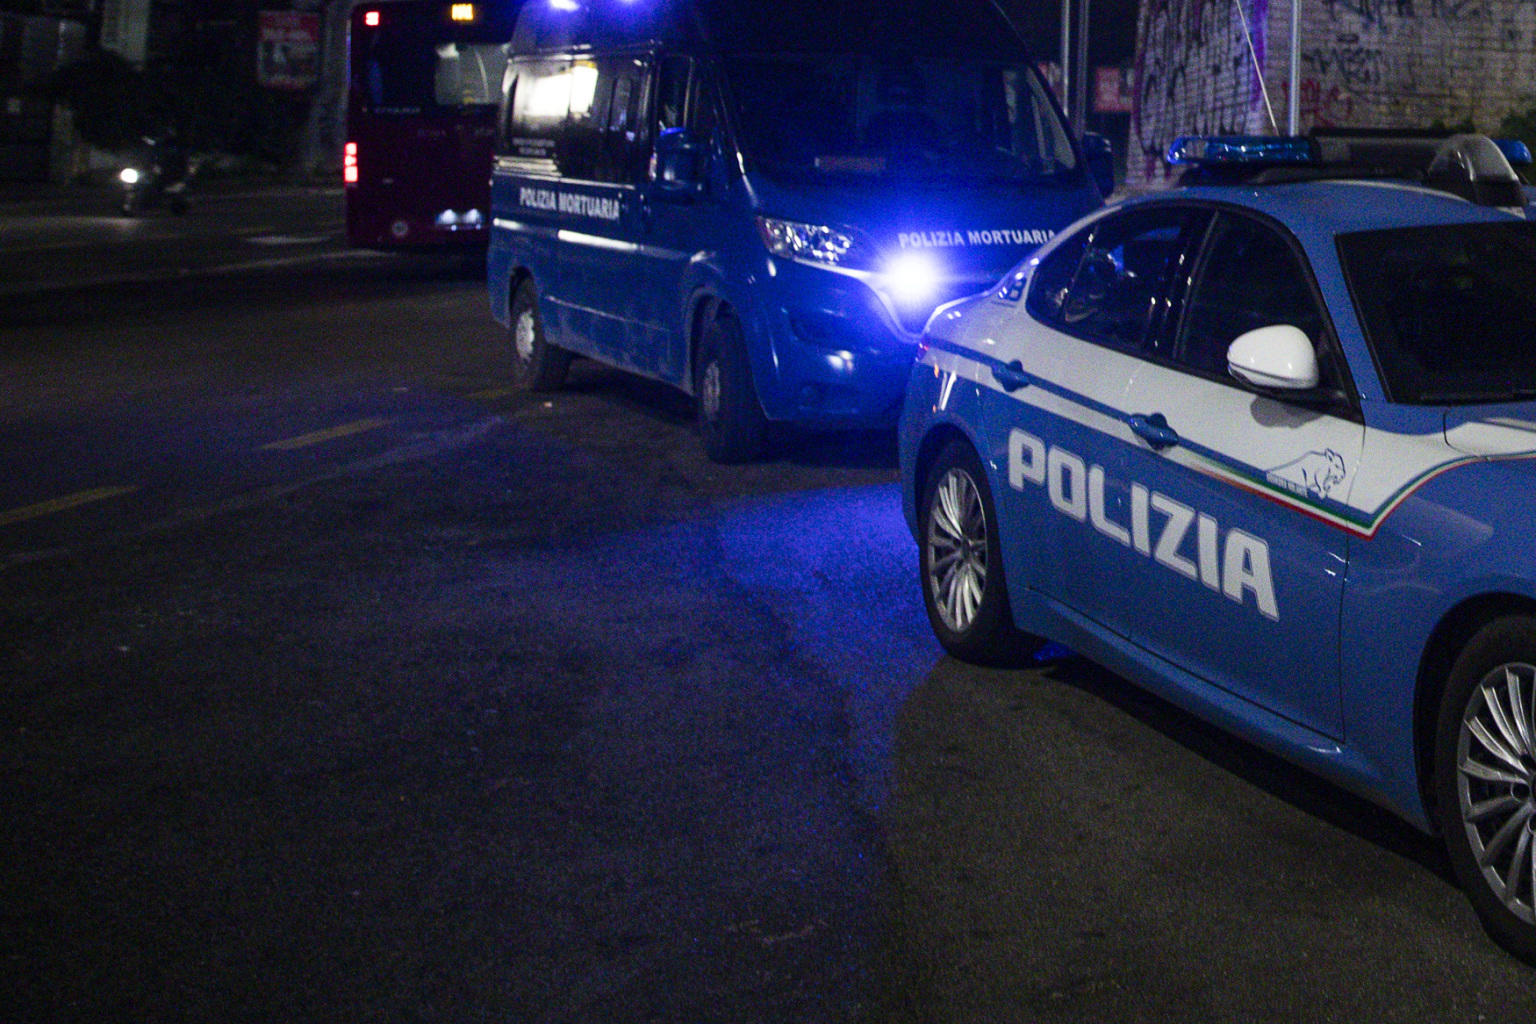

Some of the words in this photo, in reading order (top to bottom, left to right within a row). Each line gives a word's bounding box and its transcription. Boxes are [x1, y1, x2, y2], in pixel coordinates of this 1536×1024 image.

[519, 186, 557, 211] POLIZIA
[558, 191, 619, 220] MORTUARIA
[898, 231, 965, 248] POLIZIA
[1007, 426, 1281, 623] POLIZIA
